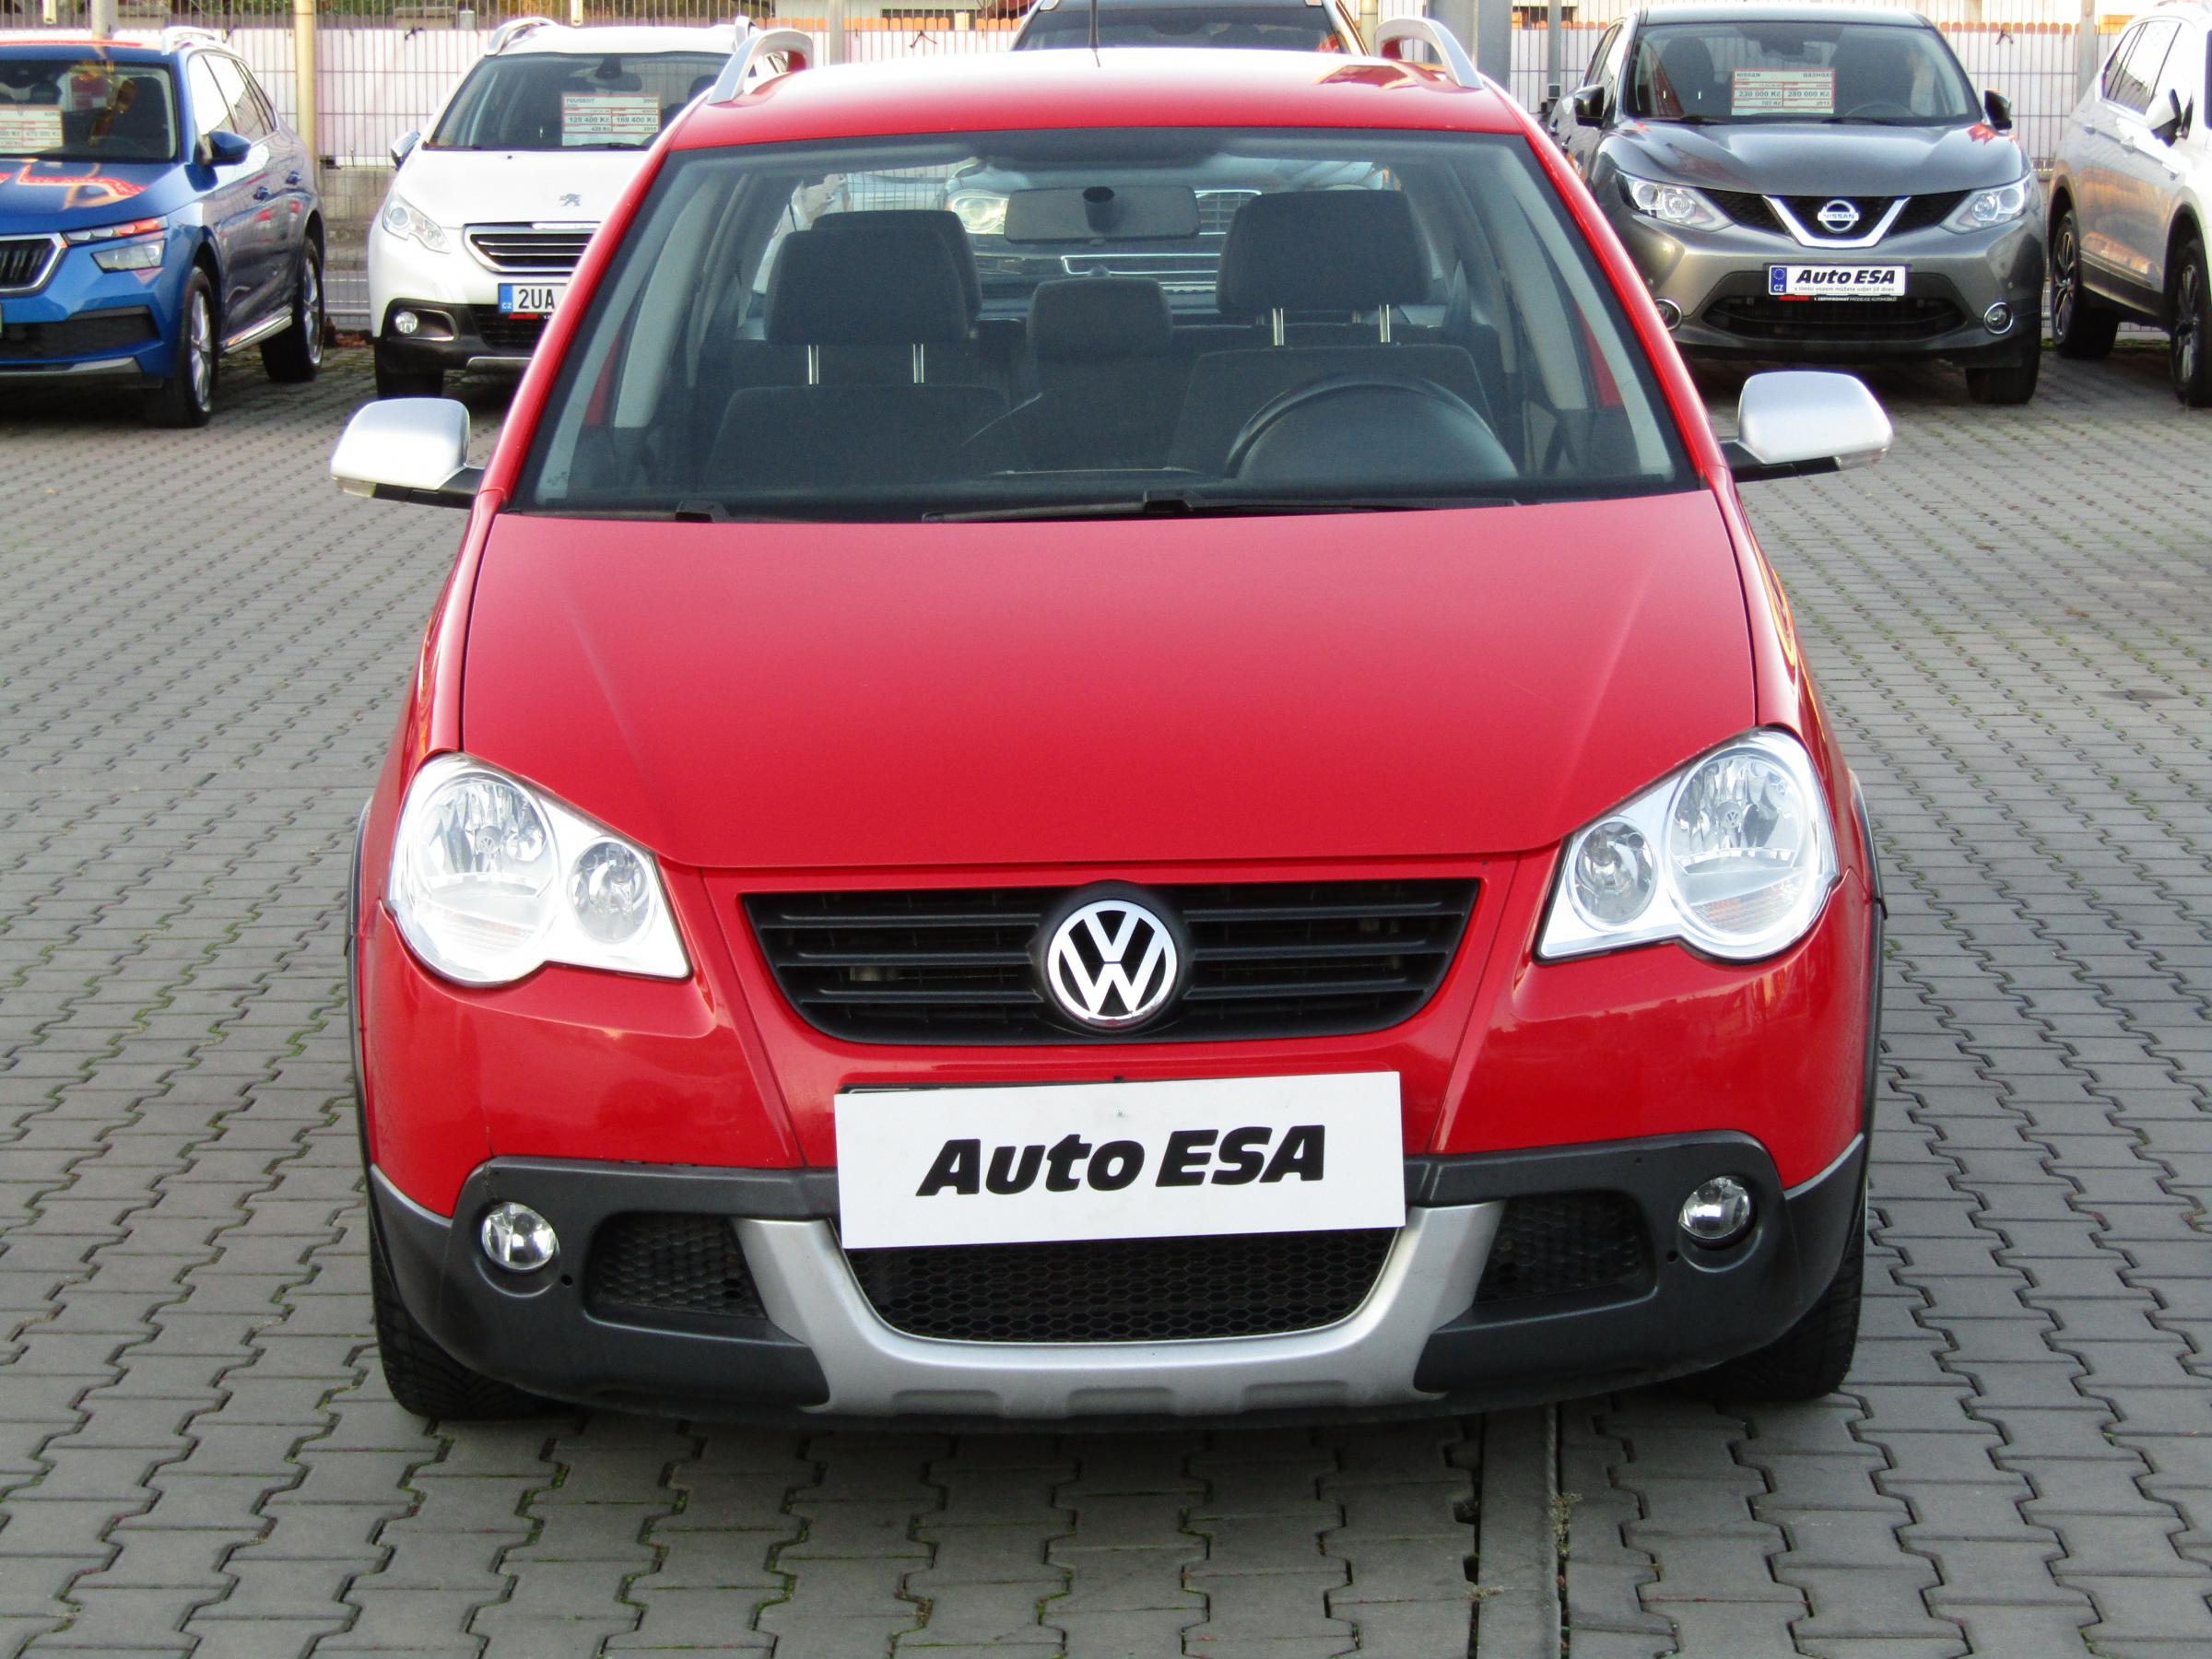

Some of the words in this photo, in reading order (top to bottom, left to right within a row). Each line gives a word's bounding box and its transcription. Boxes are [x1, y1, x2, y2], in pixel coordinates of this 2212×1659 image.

[518, 288, 555, 309] 2UA
[1795, 269, 1852, 284] Auto
[1853, 270, 1895, 284] ESA
[1050, 901, 1176, 1020] VW
[915, 1134, 1146, 1196] Auto
[1156, 1124, 1325, 1188] ESA
